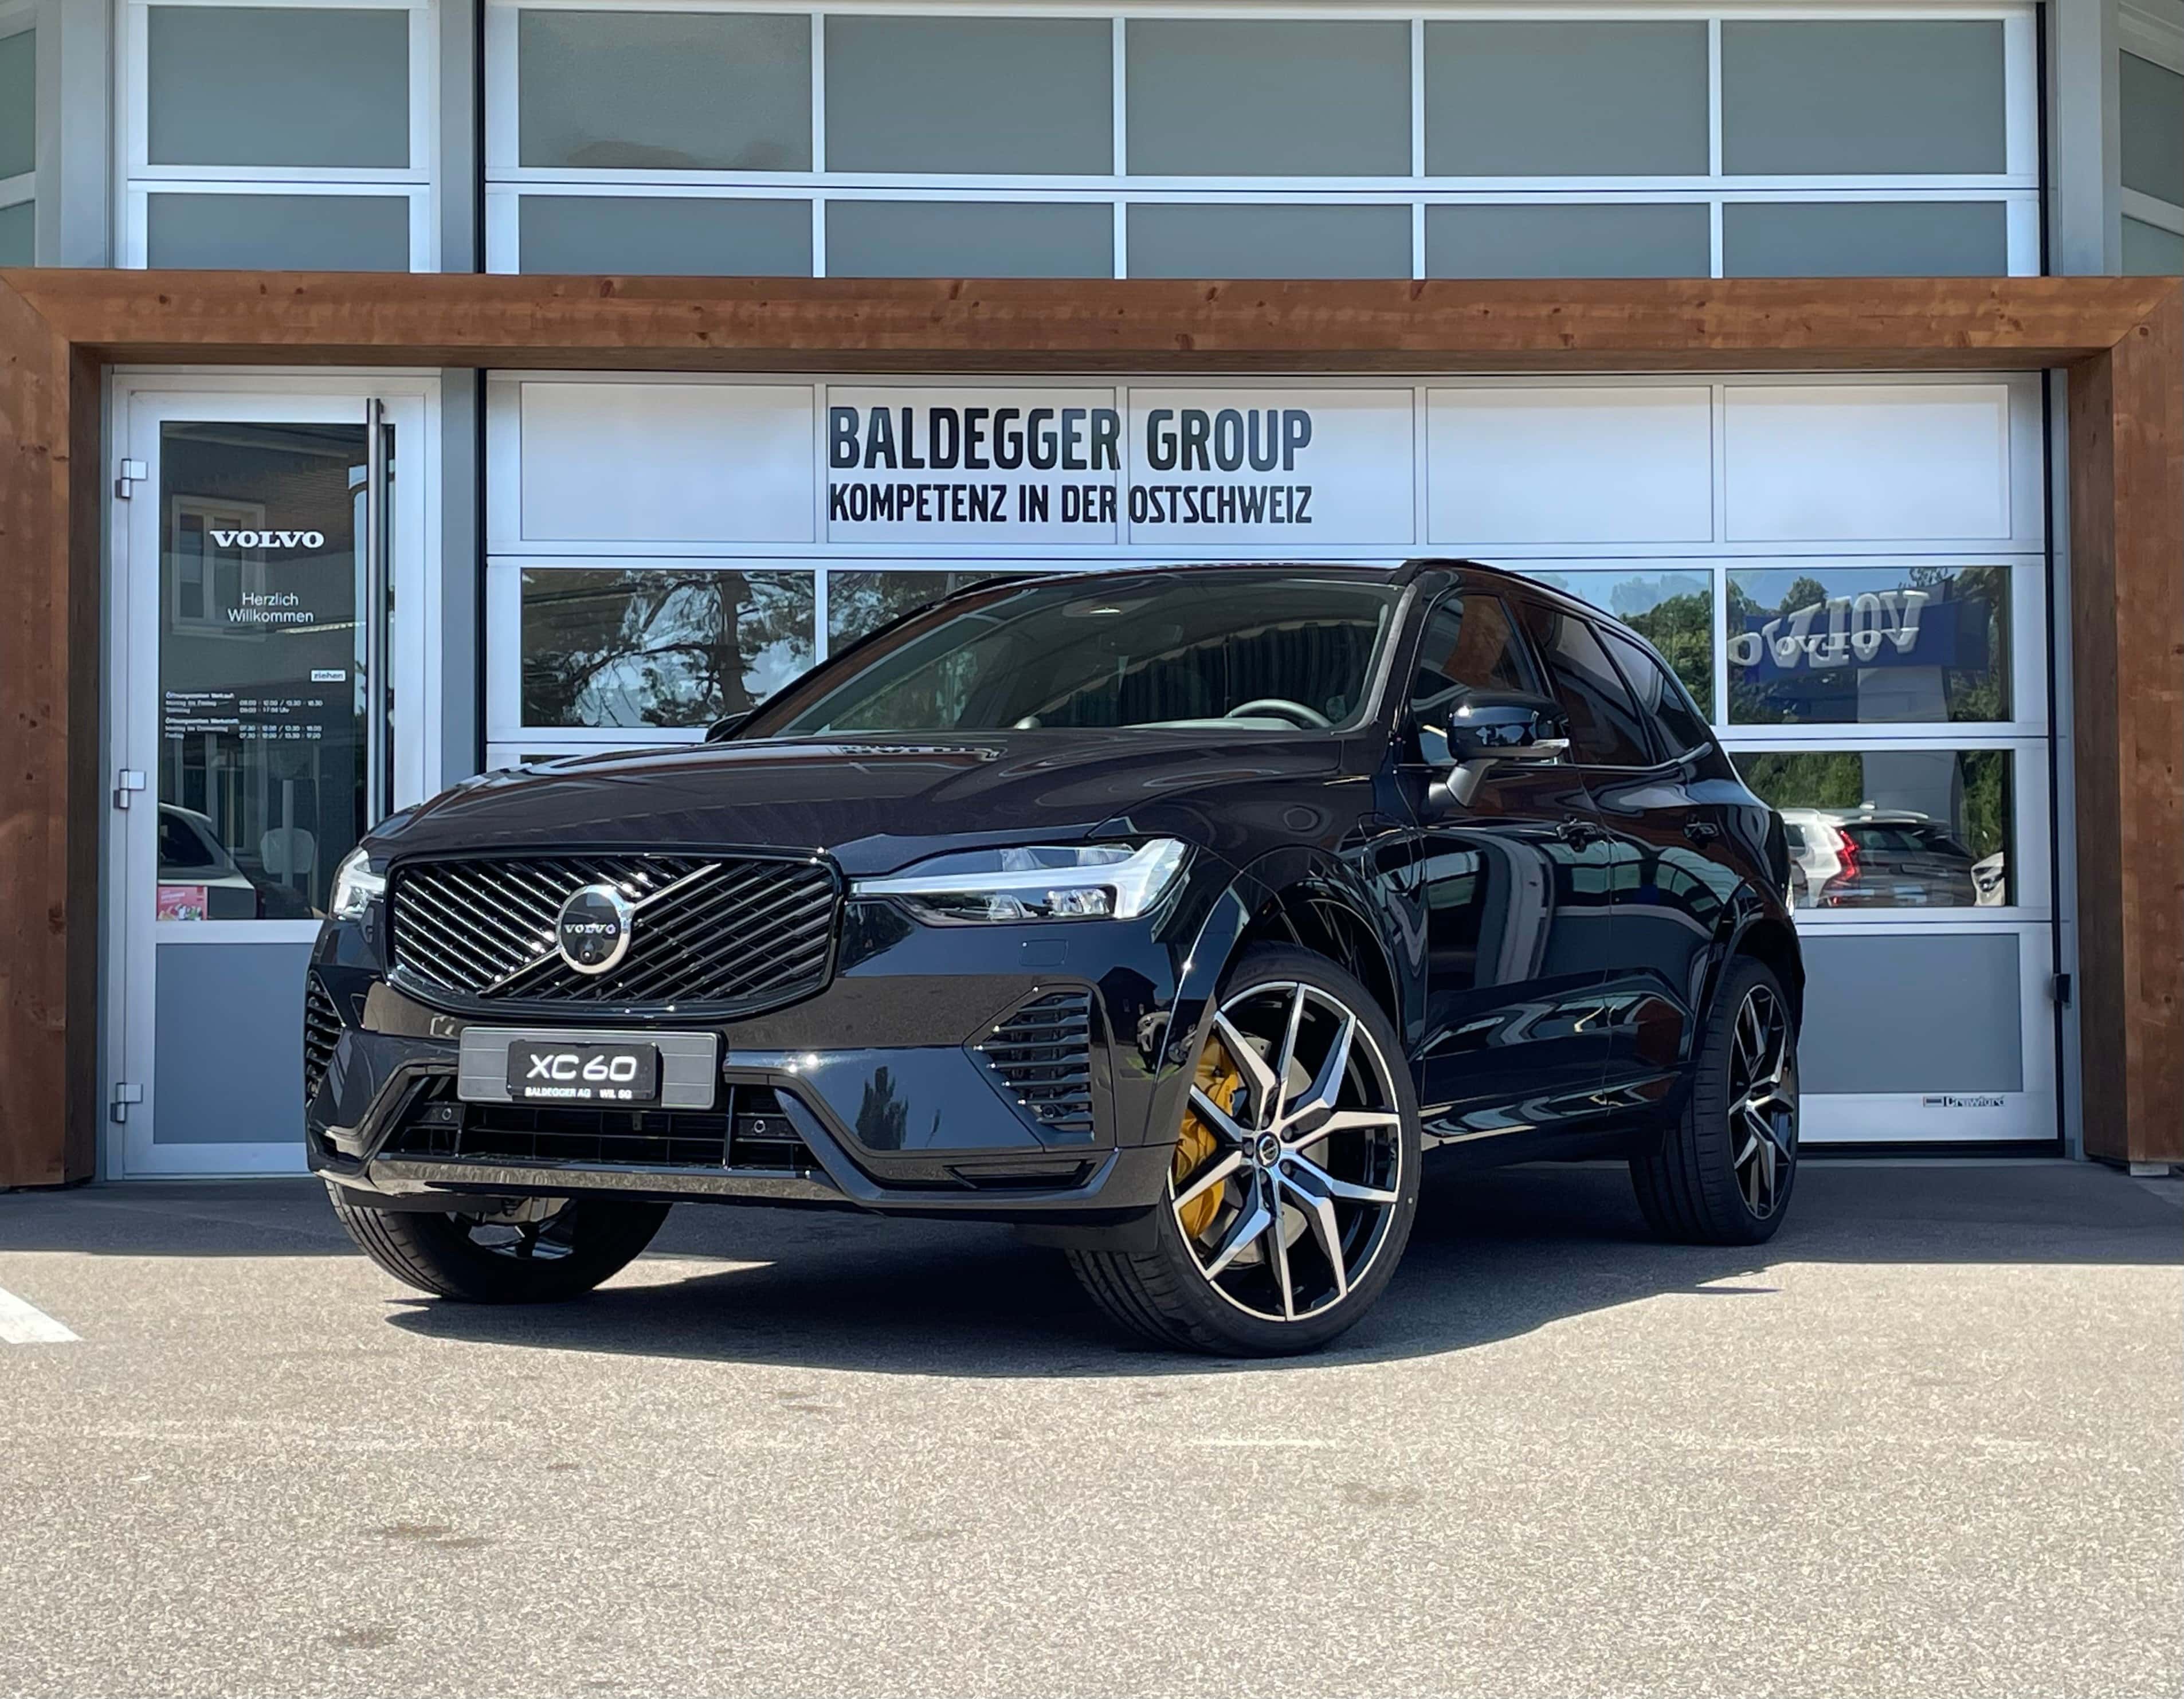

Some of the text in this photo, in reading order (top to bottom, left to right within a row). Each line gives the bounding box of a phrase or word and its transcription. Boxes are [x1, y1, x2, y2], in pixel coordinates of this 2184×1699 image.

[829, 407, 1312, 472] BALDEGGER GROUP
[829, 483, 1312, 524] KOMPETENZ IN DER OSTSCHWEIZ
[210, 530, 324, 548] VOLVO
[242, 593, 299, 606] Herzlich
[228, 609, 313, 623] Willkommen
[313, 672, 344, 680] ziehen
[564, 923, 616, 935] VOLVO
[577, 1088, 591, 1098] AG
